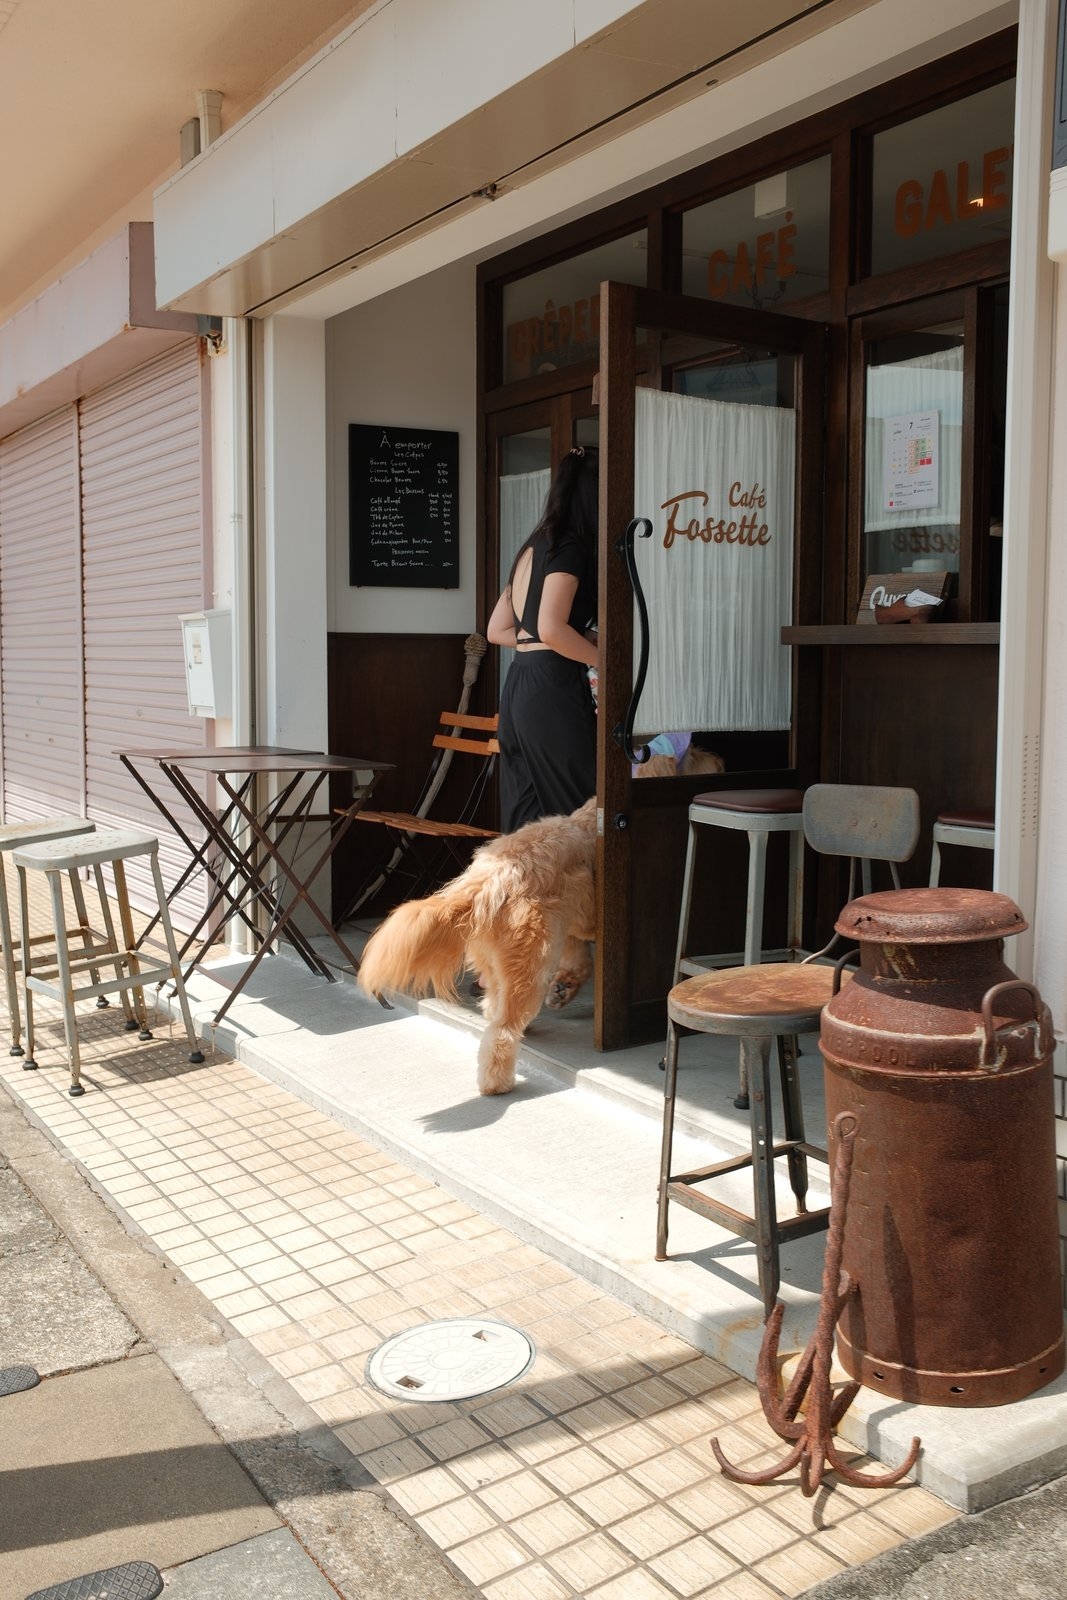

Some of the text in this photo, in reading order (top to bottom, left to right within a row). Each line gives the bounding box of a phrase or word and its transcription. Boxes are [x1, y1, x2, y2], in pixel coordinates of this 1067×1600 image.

[894, 146, 1013, 240] GALE
[707, 211, 798, 299] CAFÉ
[394, 442, 433, 451] emporter
[660, 490, 772, 549] Fossette
[729, 481, 767, 509] Café
